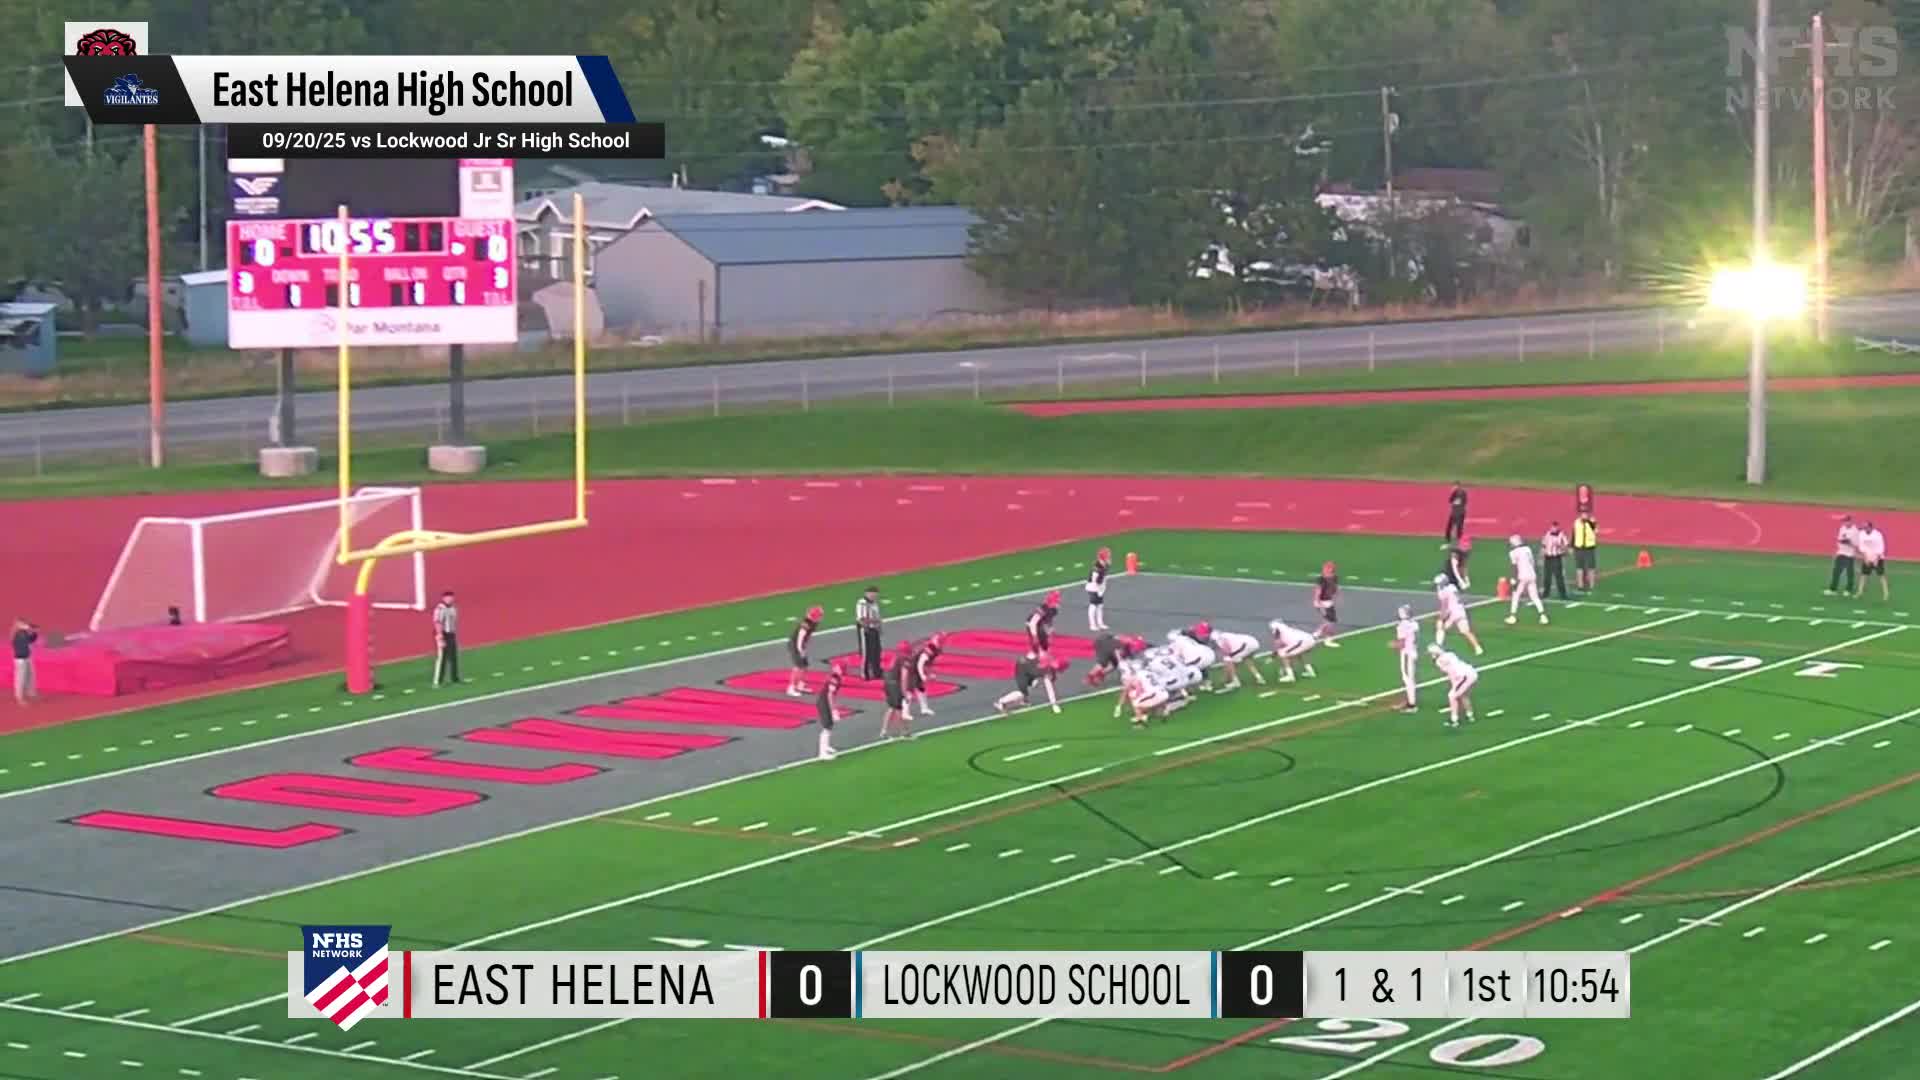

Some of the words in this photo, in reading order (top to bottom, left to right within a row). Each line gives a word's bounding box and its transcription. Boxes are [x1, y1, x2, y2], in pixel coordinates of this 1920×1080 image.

[255, 239, 275, 267] 0
[488, 235, 508, 263] 0
[1268, 1018, 1546, 1067] 20
